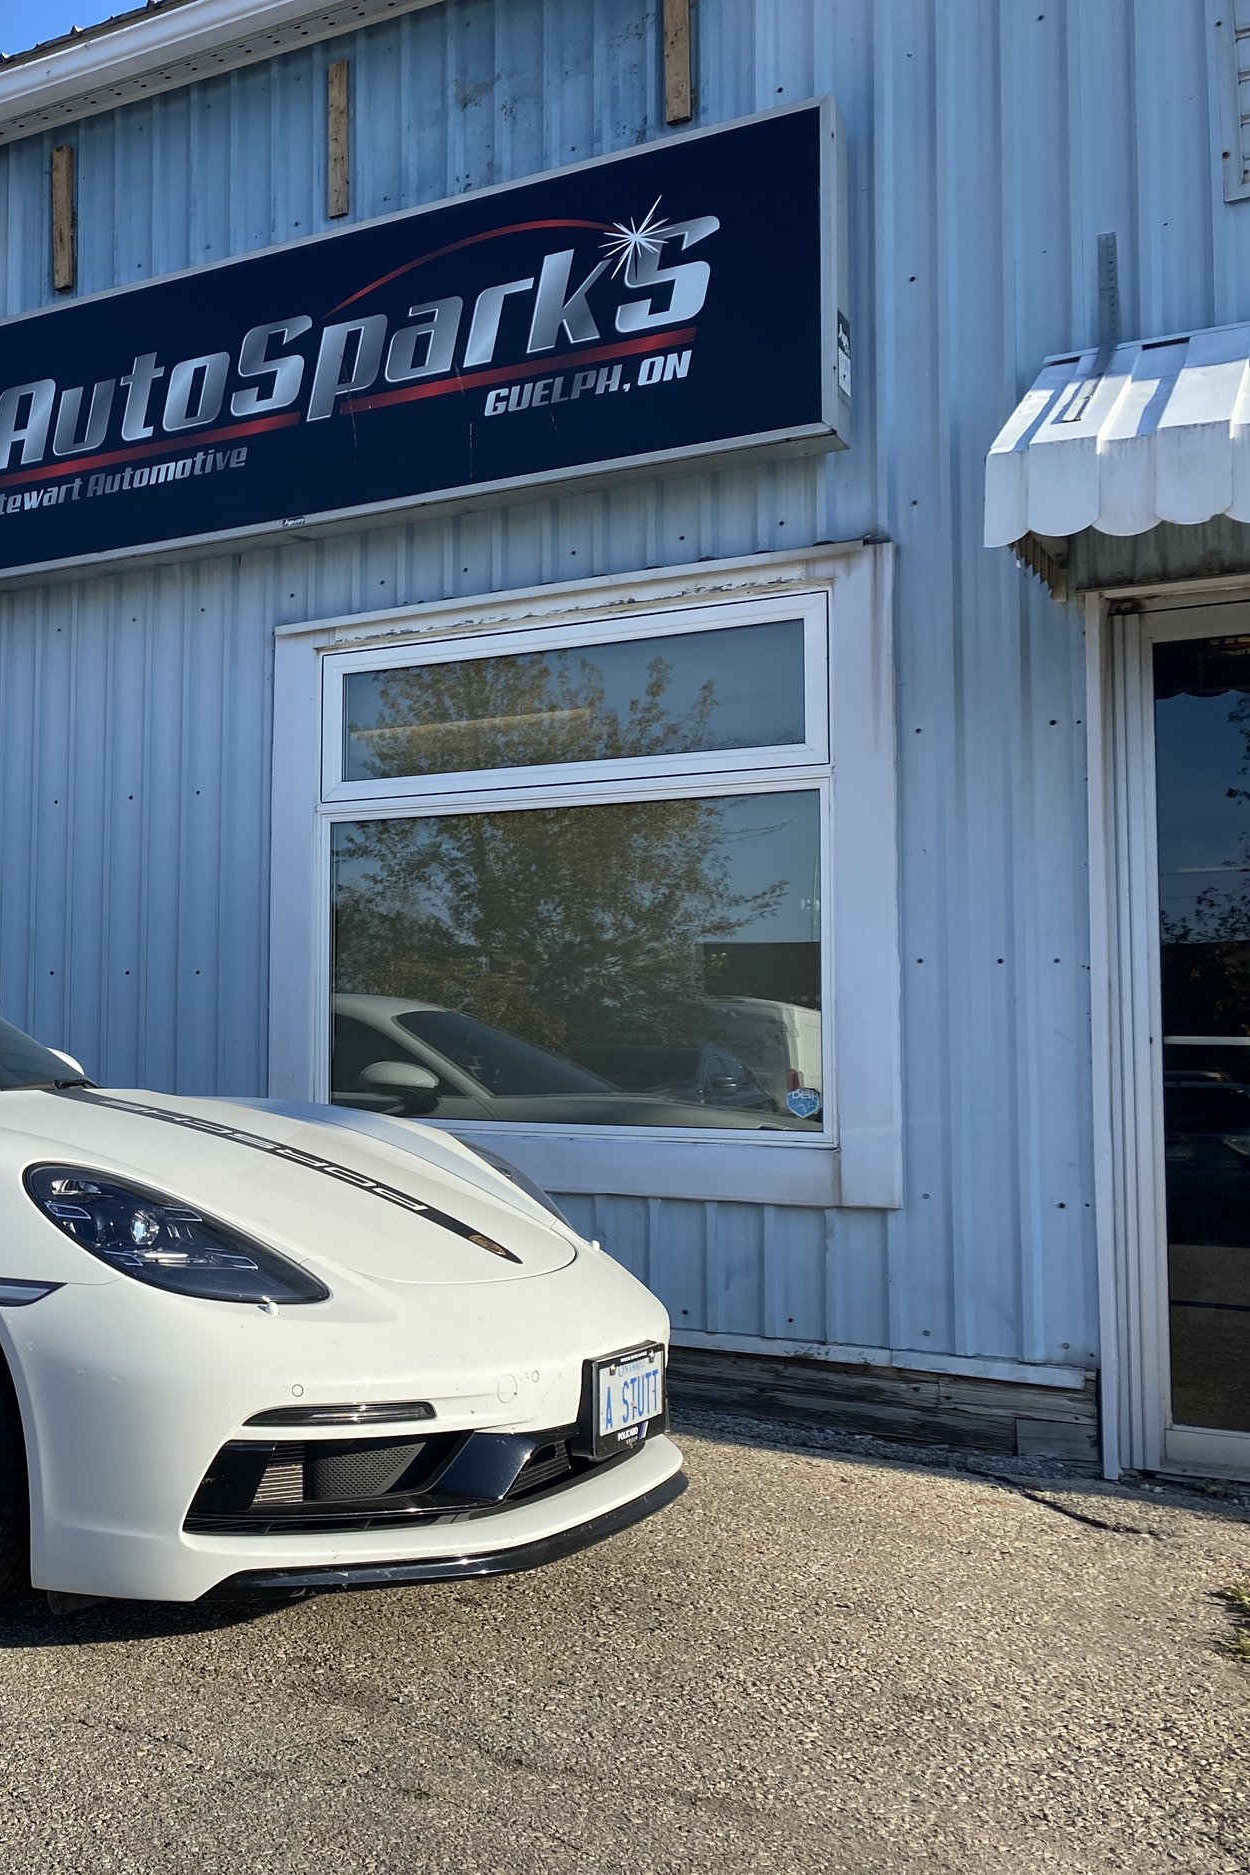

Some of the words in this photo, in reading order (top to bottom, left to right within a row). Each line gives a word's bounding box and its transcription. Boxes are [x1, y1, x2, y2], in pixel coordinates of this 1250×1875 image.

[484, 364, 631, 416] GUELPH,
[637, 350, 692, 386] ON
[86, 446, 248, 498] Automotive
[99, 1099, 428, 1211] PORSCHE
[605, 1386, 613, 1430] A
[622, 1369, 659, 1423] STUTT
